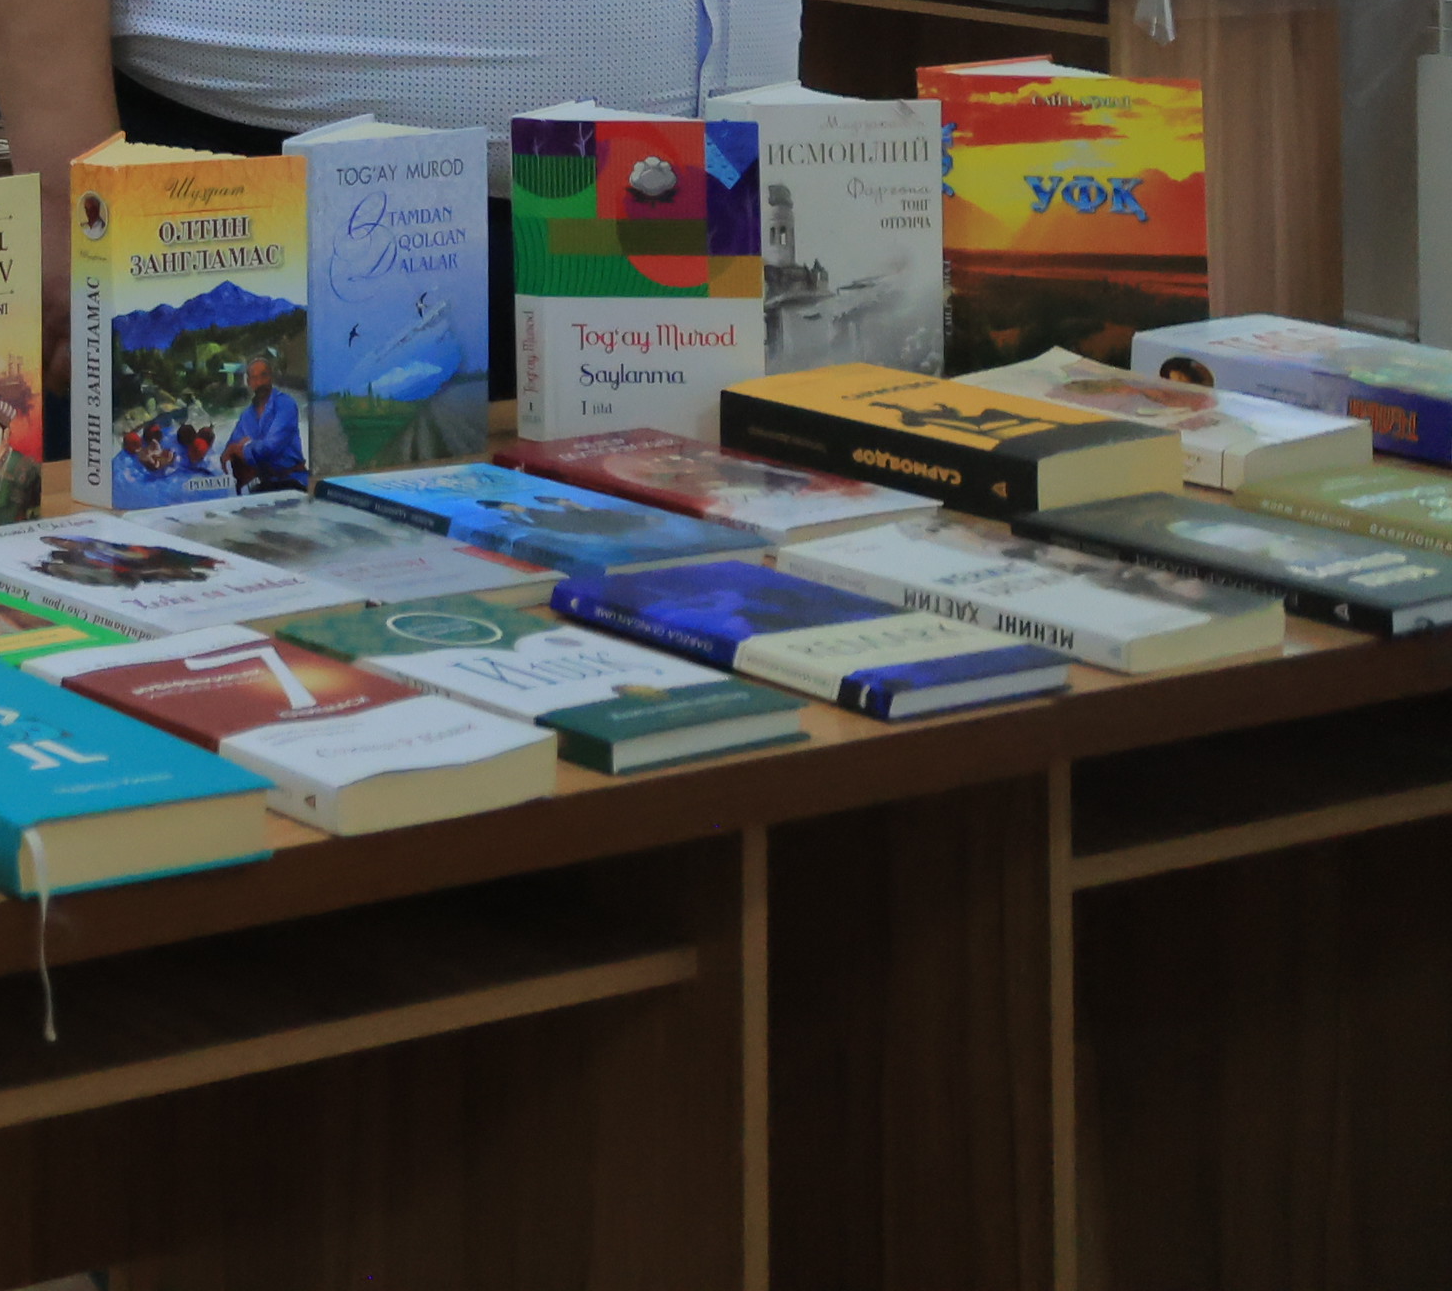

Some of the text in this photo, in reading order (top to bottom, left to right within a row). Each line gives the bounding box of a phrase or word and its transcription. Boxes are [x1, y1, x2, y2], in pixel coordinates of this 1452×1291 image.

[768, 136, 929, 166] ИСМОИЛИЙ
[406, 159, 464, 180] MUROD
[901, 199, 931, 211] ТОНГ
[1024, 175, 1149, 222] УФҚ
[158, 216, 250, 245] ОЛТИН
[129, 244, 281, 278] ЗАНГЛАМАС
[86, 276, 101, 407] ЗАНГЛАМАС
[571, 323, 738, 354] Tog‘ay Murod
[579, 363, 687, 391] Saylanma
[87, 413, 102, 487] ОЛТИН
[189, 476, 231, 491] РОМАН
[998, 613, 1074, 649] МЕНИНГ
